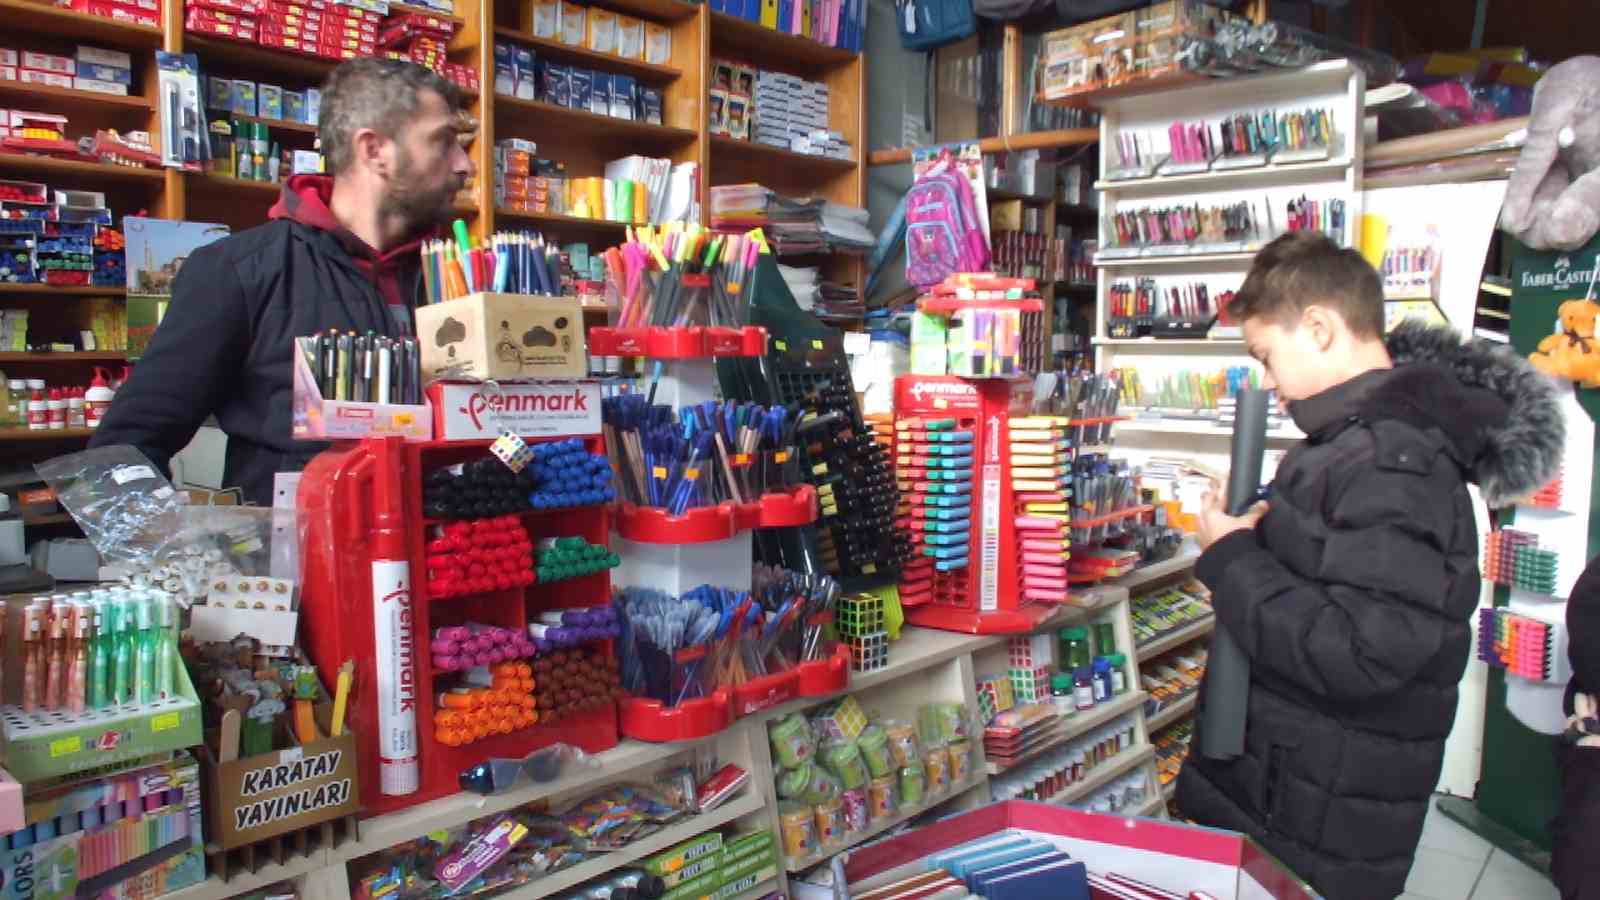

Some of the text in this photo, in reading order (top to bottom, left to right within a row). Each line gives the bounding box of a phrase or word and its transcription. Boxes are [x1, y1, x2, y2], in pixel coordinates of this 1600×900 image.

[1521, 268, 1600, 287] FABER-CASTE
[241, 751, 341, 796] KARATAY
[235, 780, 351, 830] YAYINLARI
